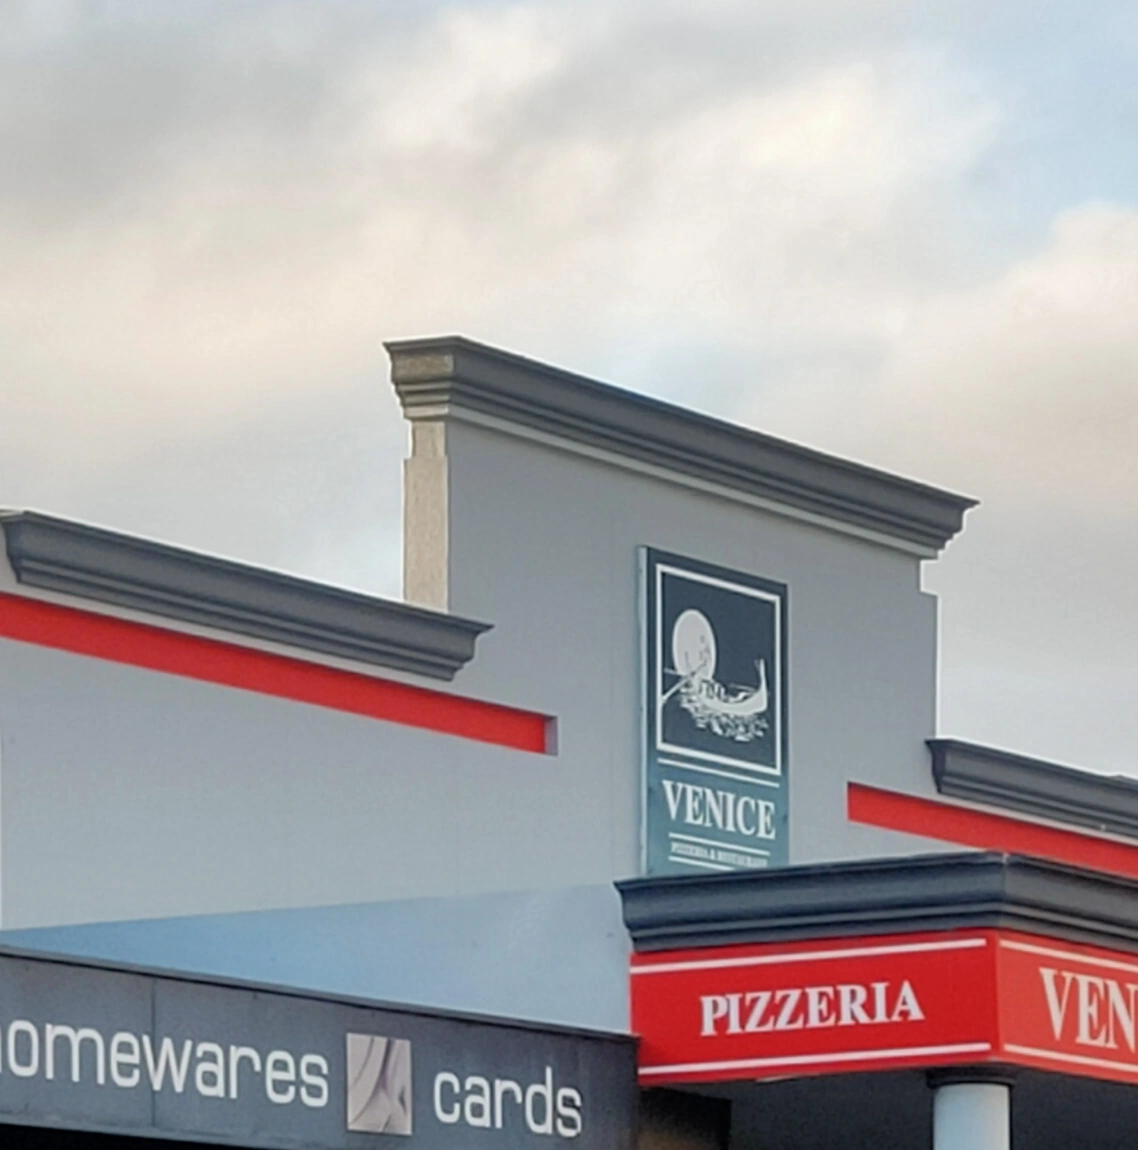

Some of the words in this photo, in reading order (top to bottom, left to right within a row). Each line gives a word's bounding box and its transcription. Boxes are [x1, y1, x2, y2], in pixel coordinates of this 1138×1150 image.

[661, 779, 776, 840] VENICE
[700, 979, 925, 1037] PIZZERIA
[0, 1018, 329, 1107] omewares
[433, 1066, 582, 1137] cards
